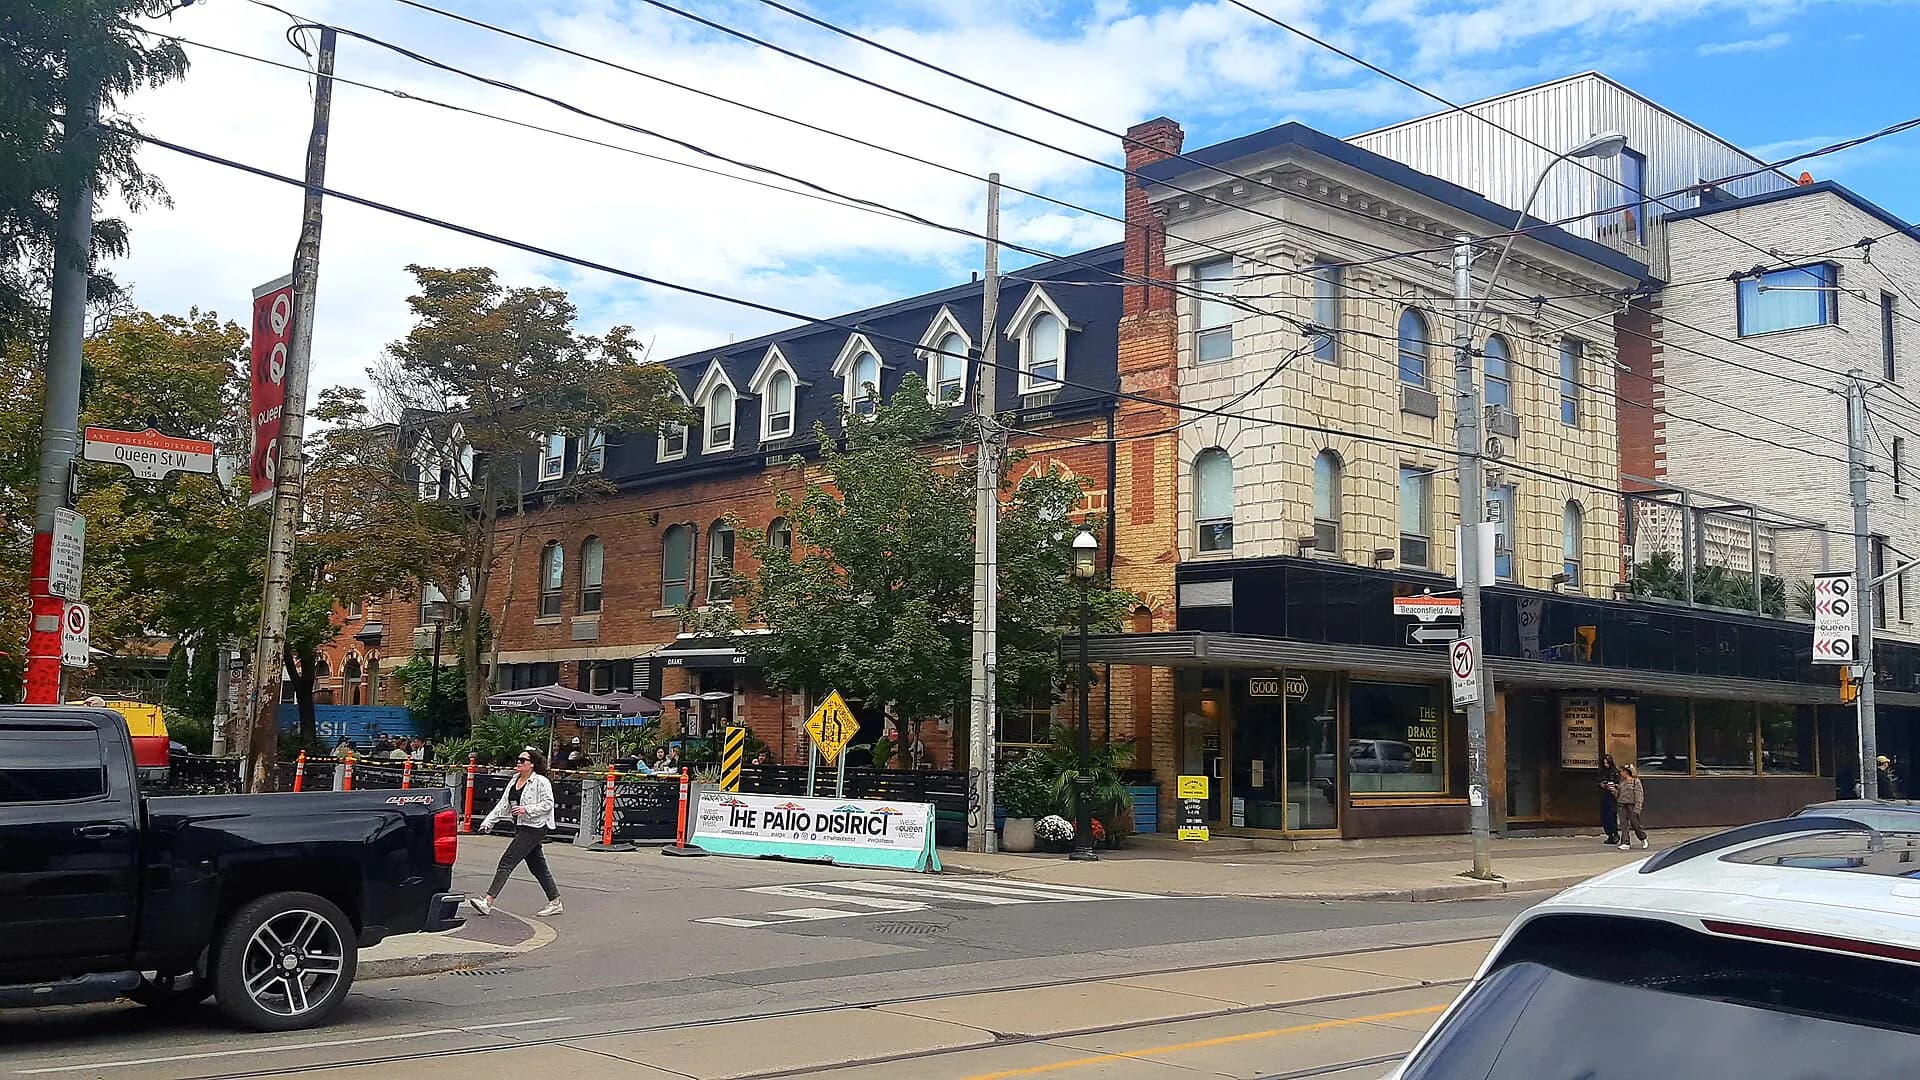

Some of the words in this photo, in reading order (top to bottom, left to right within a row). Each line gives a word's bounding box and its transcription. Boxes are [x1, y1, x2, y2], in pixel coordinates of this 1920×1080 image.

[125, 438, 159, 447] DESIGN
[165, 442, 206, 452] DISTRICT
[115, 446, 156, 464] Queen
[161, 452, 172, 466] St
[176, 455, 187, 467] W
[141, 470, 157, 478] 1154
[1400, 605, 1443, 614] Beaconsfield
[1445, 606, 1454, 614] Av
[1251, 682, 1278, 694] GOOD
[1287, 682, 1305, 694] FOOD
[1420, 707, 1436, 718] THE
[1407, 726, 1437, 738] DRAKE
[727, 804, 757, 829] THE
[763, 807, 811, 832] PATIO
[815, 811, 889, 836] DISTRICT
